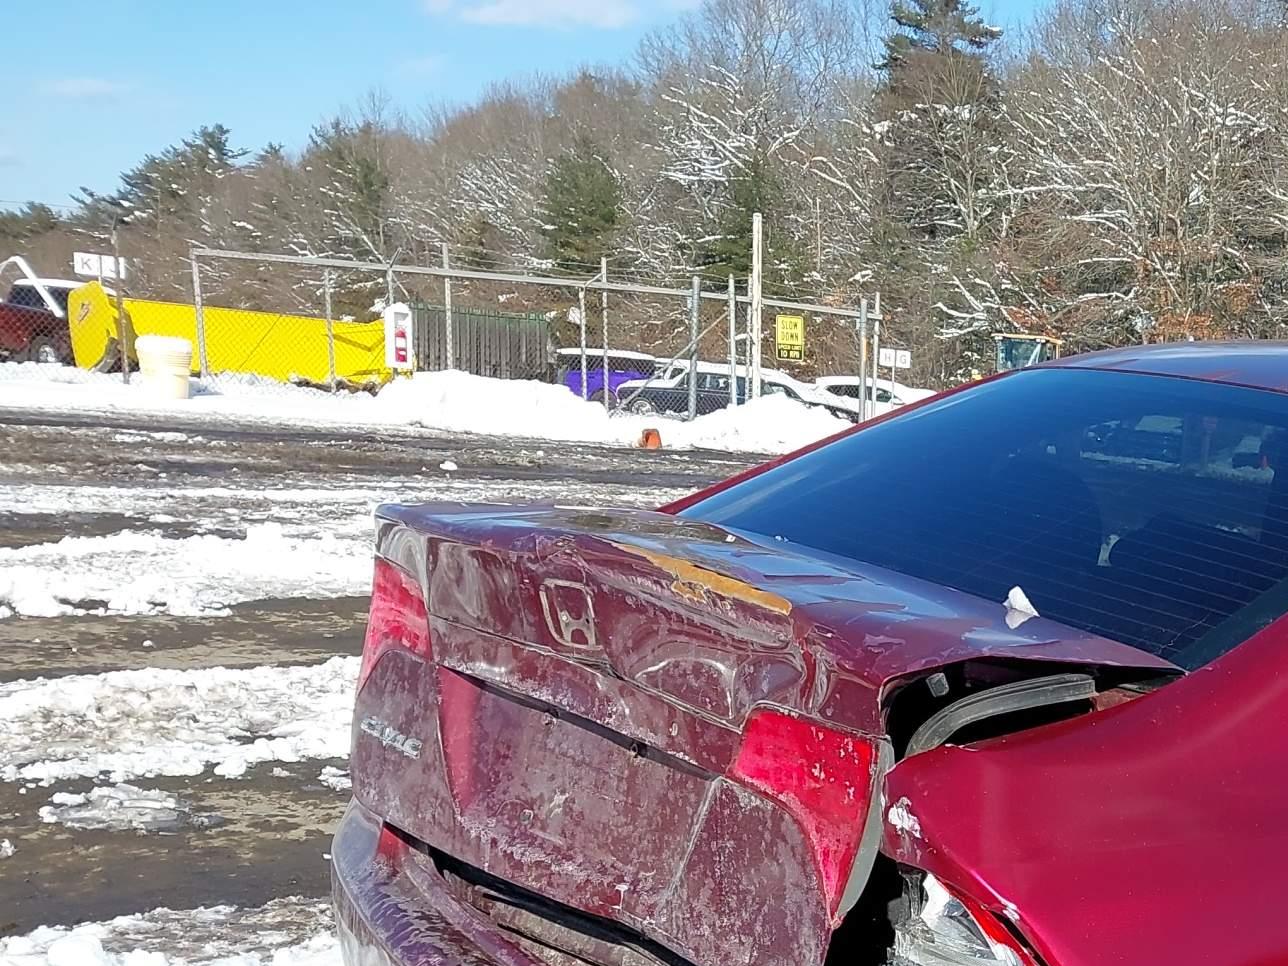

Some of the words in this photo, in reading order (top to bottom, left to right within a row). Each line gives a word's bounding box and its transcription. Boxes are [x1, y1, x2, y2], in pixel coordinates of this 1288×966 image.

[80, 256, 92, 272] K
[781, 319, 799, 330] SLOW
[780, 330, 799, 342] DOWN
[899, 354, 907, 365] G
